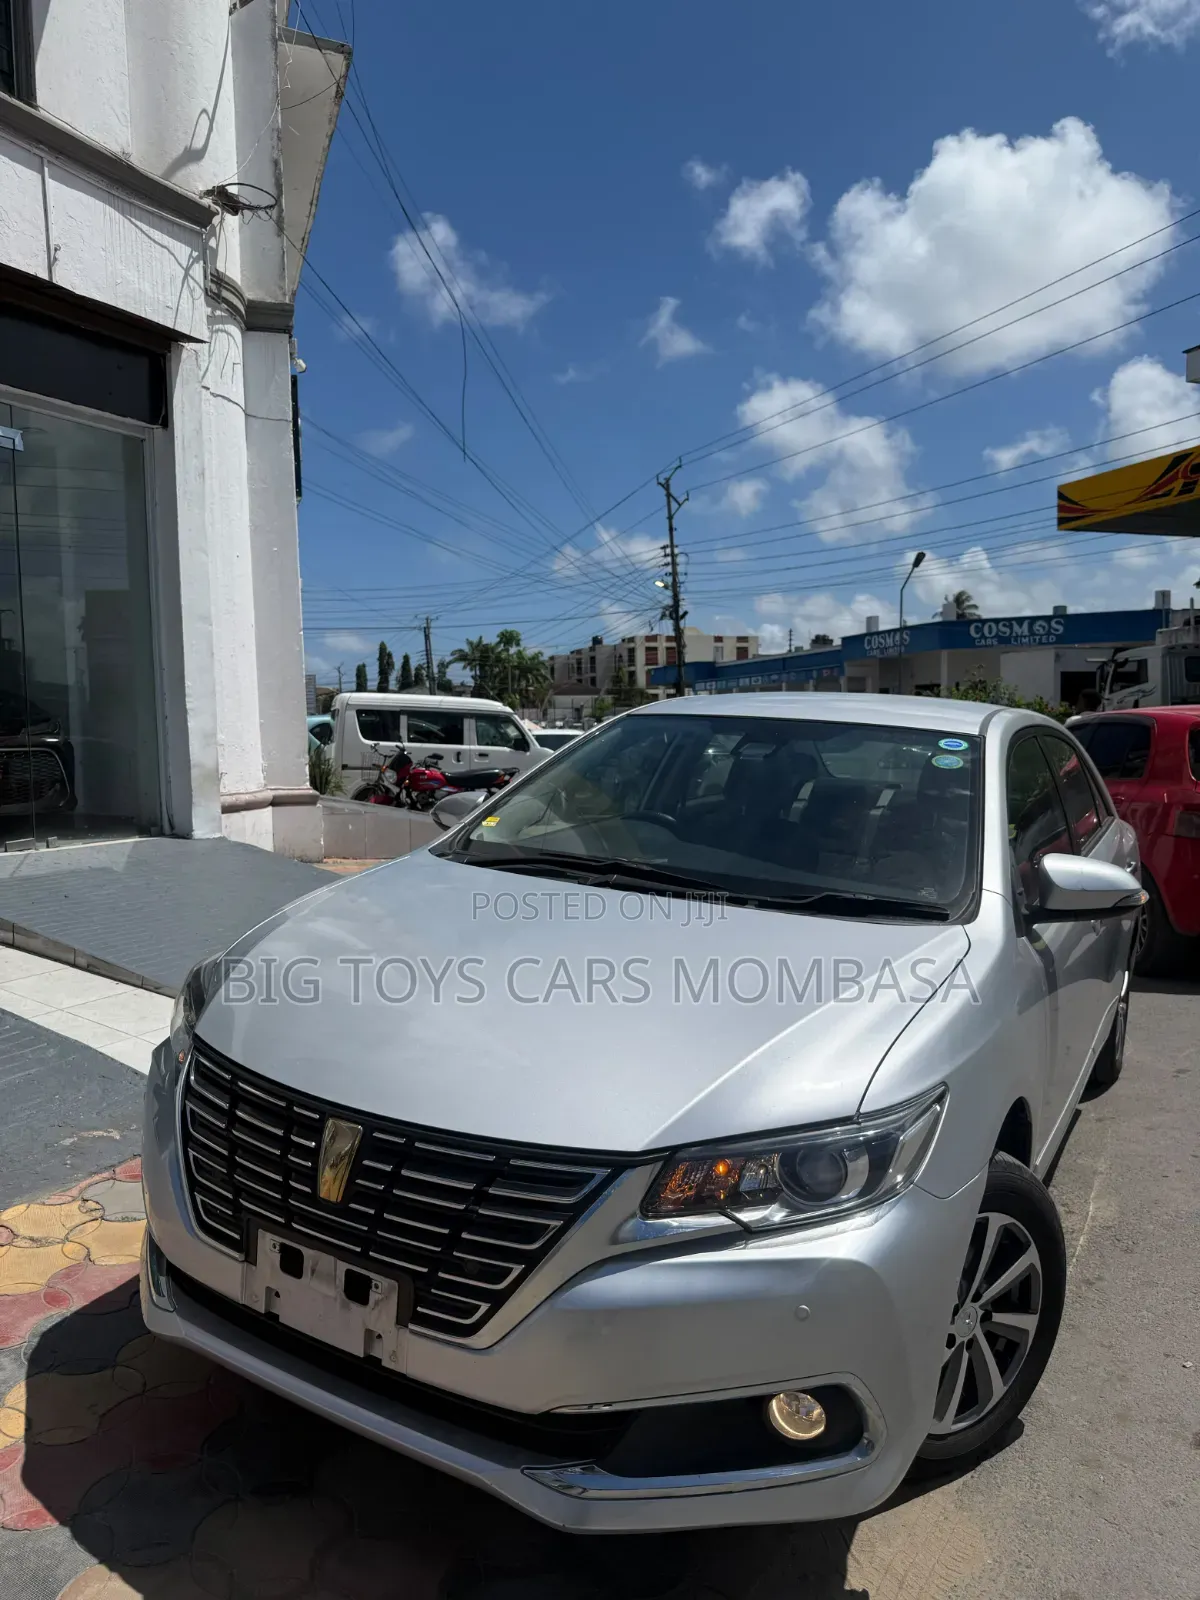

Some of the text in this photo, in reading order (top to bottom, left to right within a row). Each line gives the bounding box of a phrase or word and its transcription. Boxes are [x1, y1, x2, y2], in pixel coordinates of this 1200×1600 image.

[969, 618, 1065, 638] COSMOS
[974, 635, 1057, 646] CARS LIMITED
